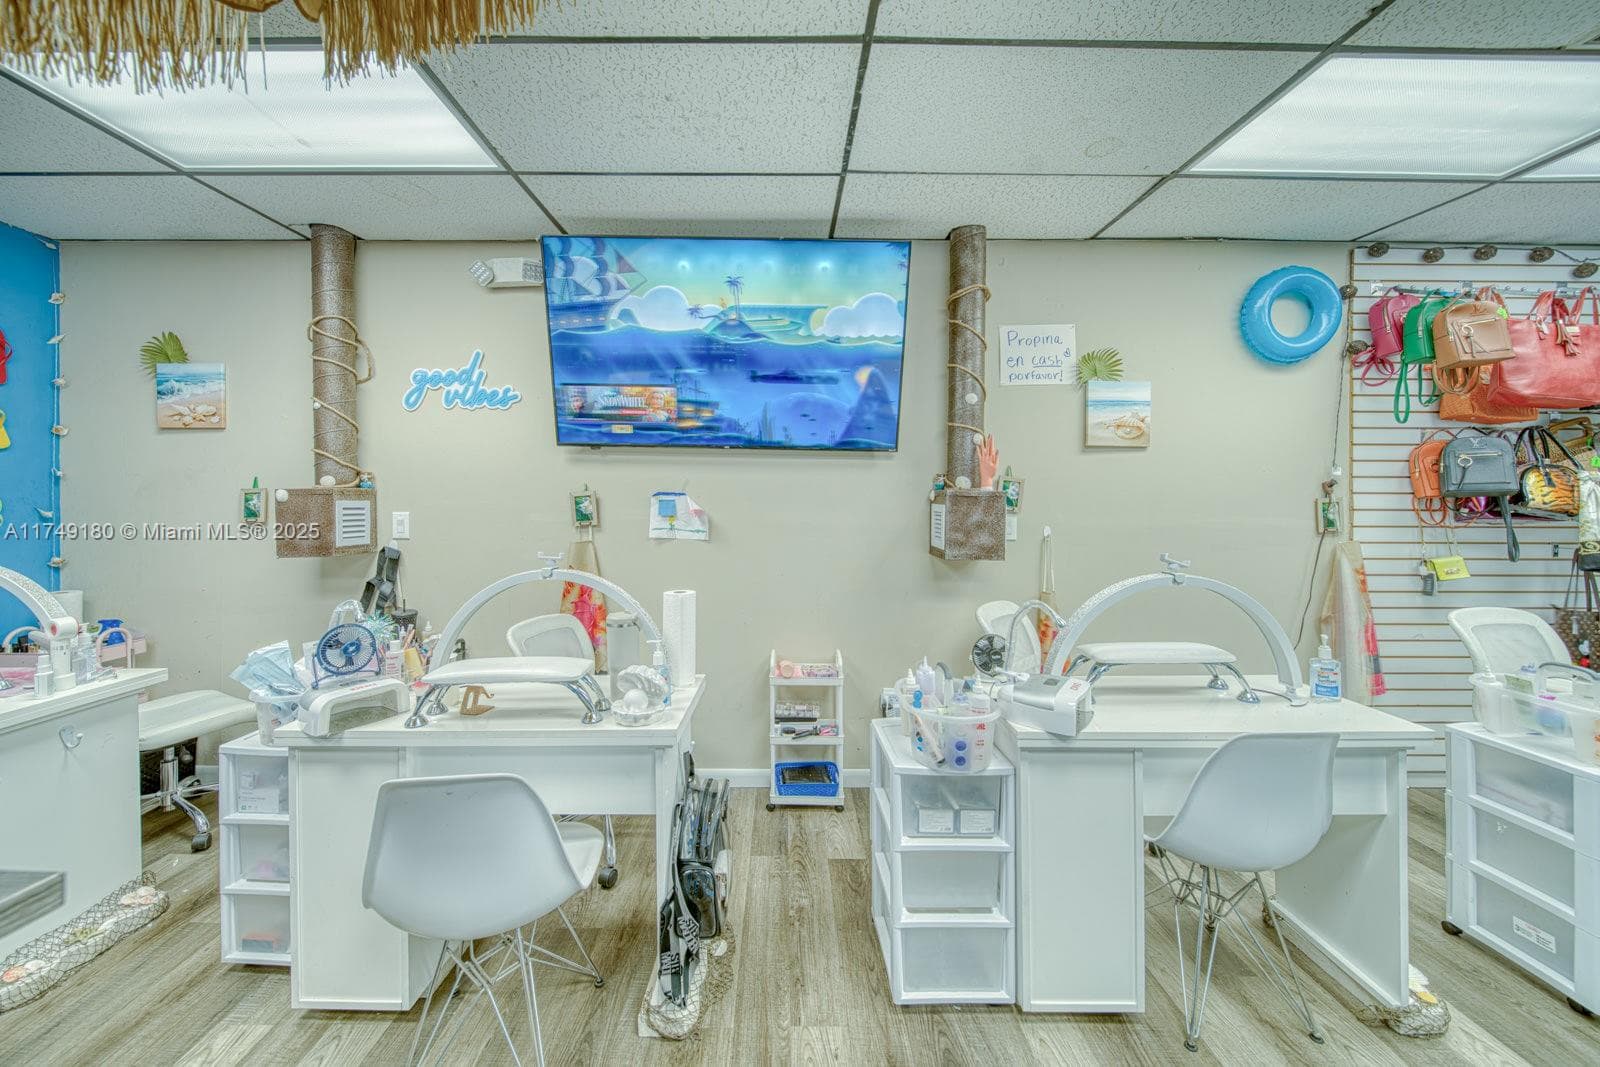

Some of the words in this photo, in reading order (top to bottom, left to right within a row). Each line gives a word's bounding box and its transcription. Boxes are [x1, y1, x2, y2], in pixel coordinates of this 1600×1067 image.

[1007, 330, 1063, 347] Propina
[1007, 355, 1024, 367] en
[1031, 354, 1063, 368] cash
[403, 350, 482, 410] good
[442, 369, 520, 409] vibes
